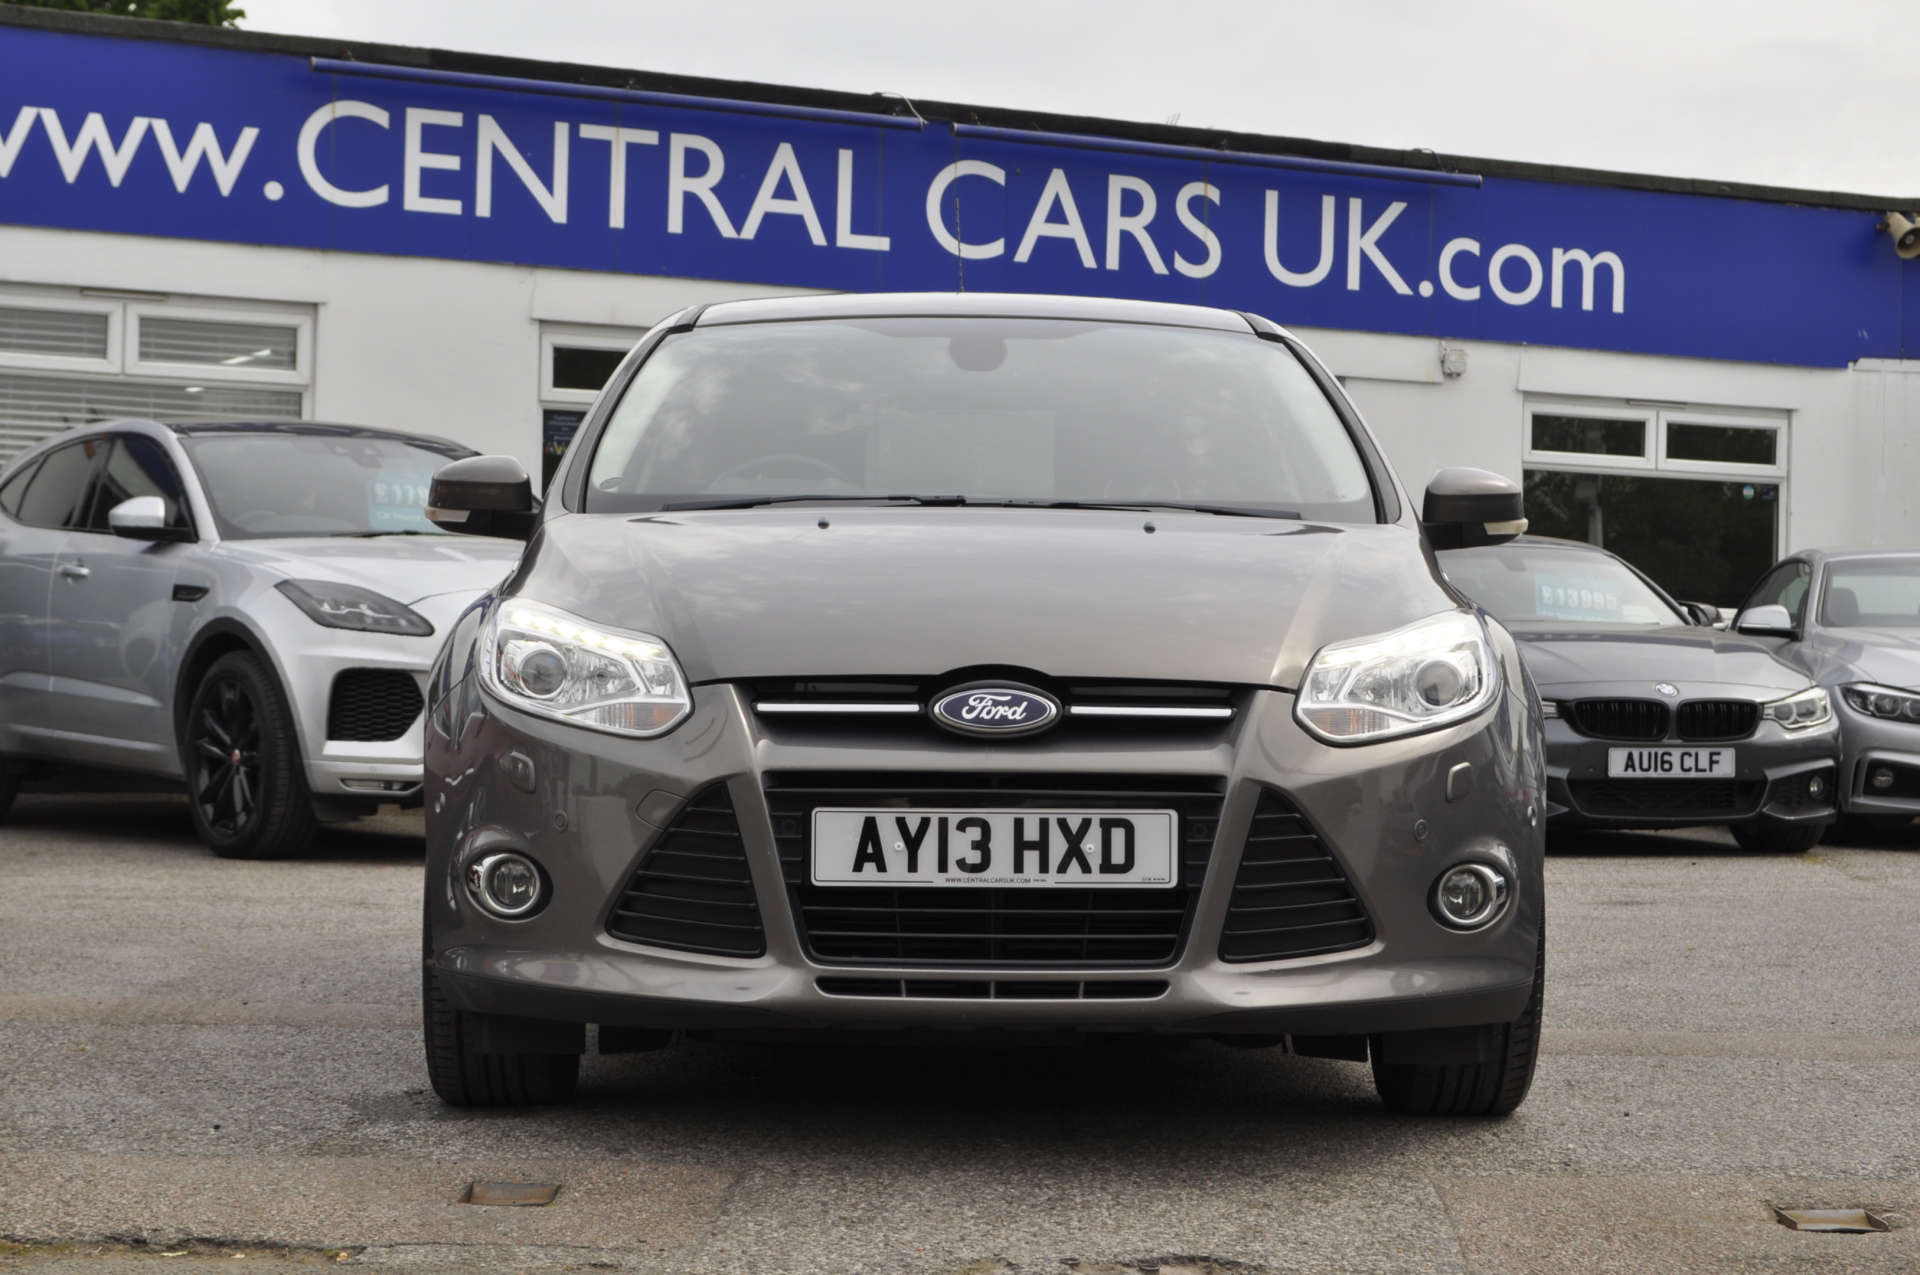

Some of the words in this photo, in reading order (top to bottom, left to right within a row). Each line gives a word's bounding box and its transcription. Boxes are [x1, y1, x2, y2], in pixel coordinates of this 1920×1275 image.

[926, 160, 1222, 279] CARS
[1263, 190, 1625, 314] UK.com
[961, 694, 1028, 720] Ford
[1623, 751, 1673, 773] AU16
[1680, 751, 1722, 773] CLF
[852, 816, 992, 874] AY13
[1013, 817, 1136, 875] HXD
